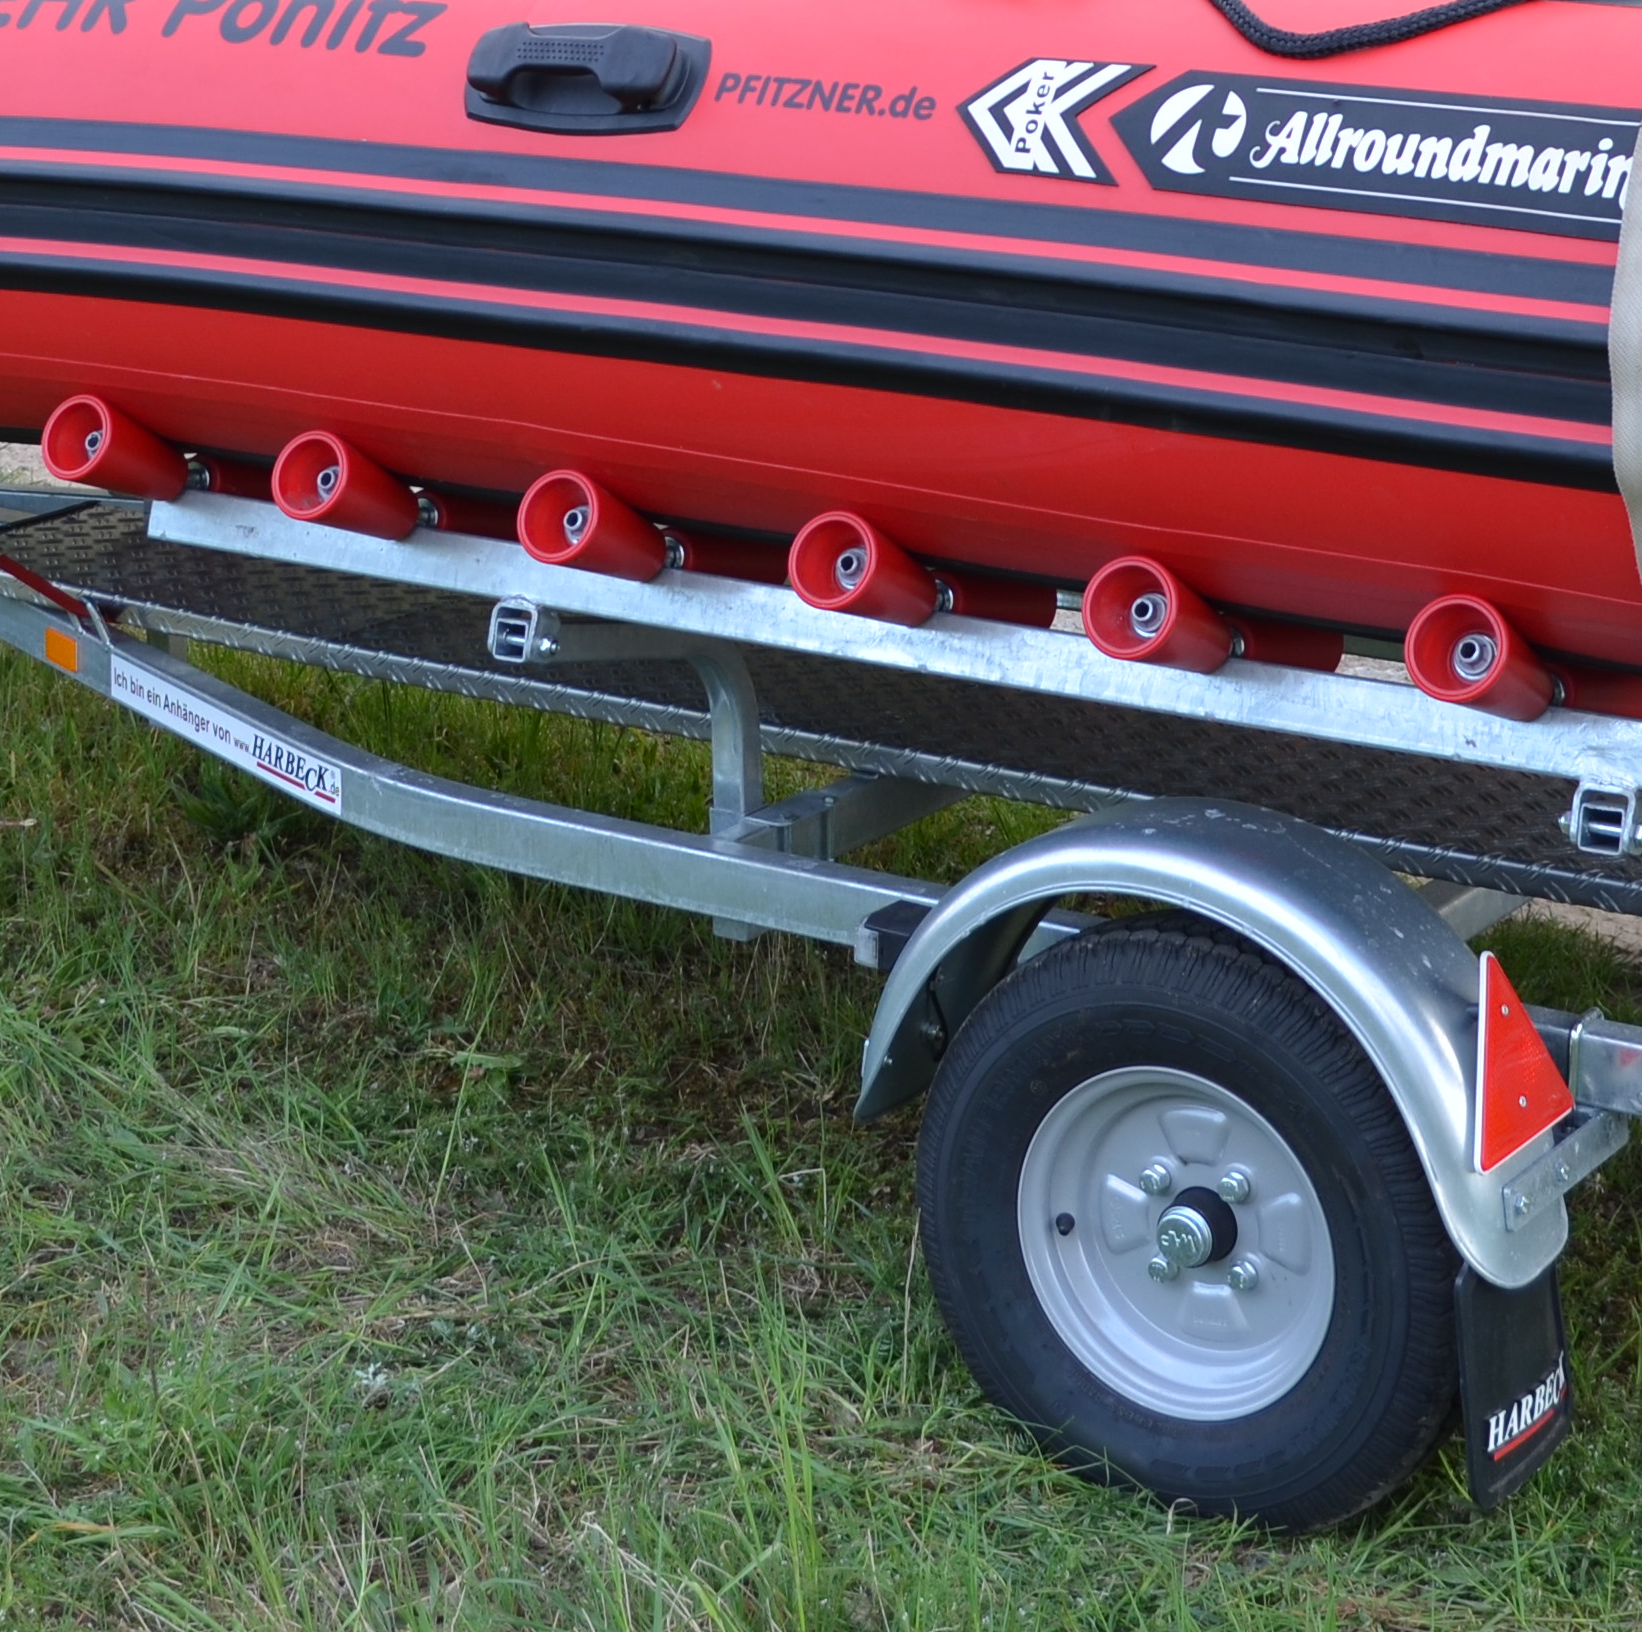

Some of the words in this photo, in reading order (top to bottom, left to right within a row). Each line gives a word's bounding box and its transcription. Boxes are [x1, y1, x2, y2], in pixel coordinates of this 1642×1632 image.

[714, 72, 937, 120] PFITZNER.de
[1014, 71, 1055, 154] Poker
[114, 667, 128, 691] Ich
[130, 676, 145, 700] bin
[147, 687, 162, 708] ein
[163, 693, 211, 733] Anhänger
[212, 722, 232, 745] von
